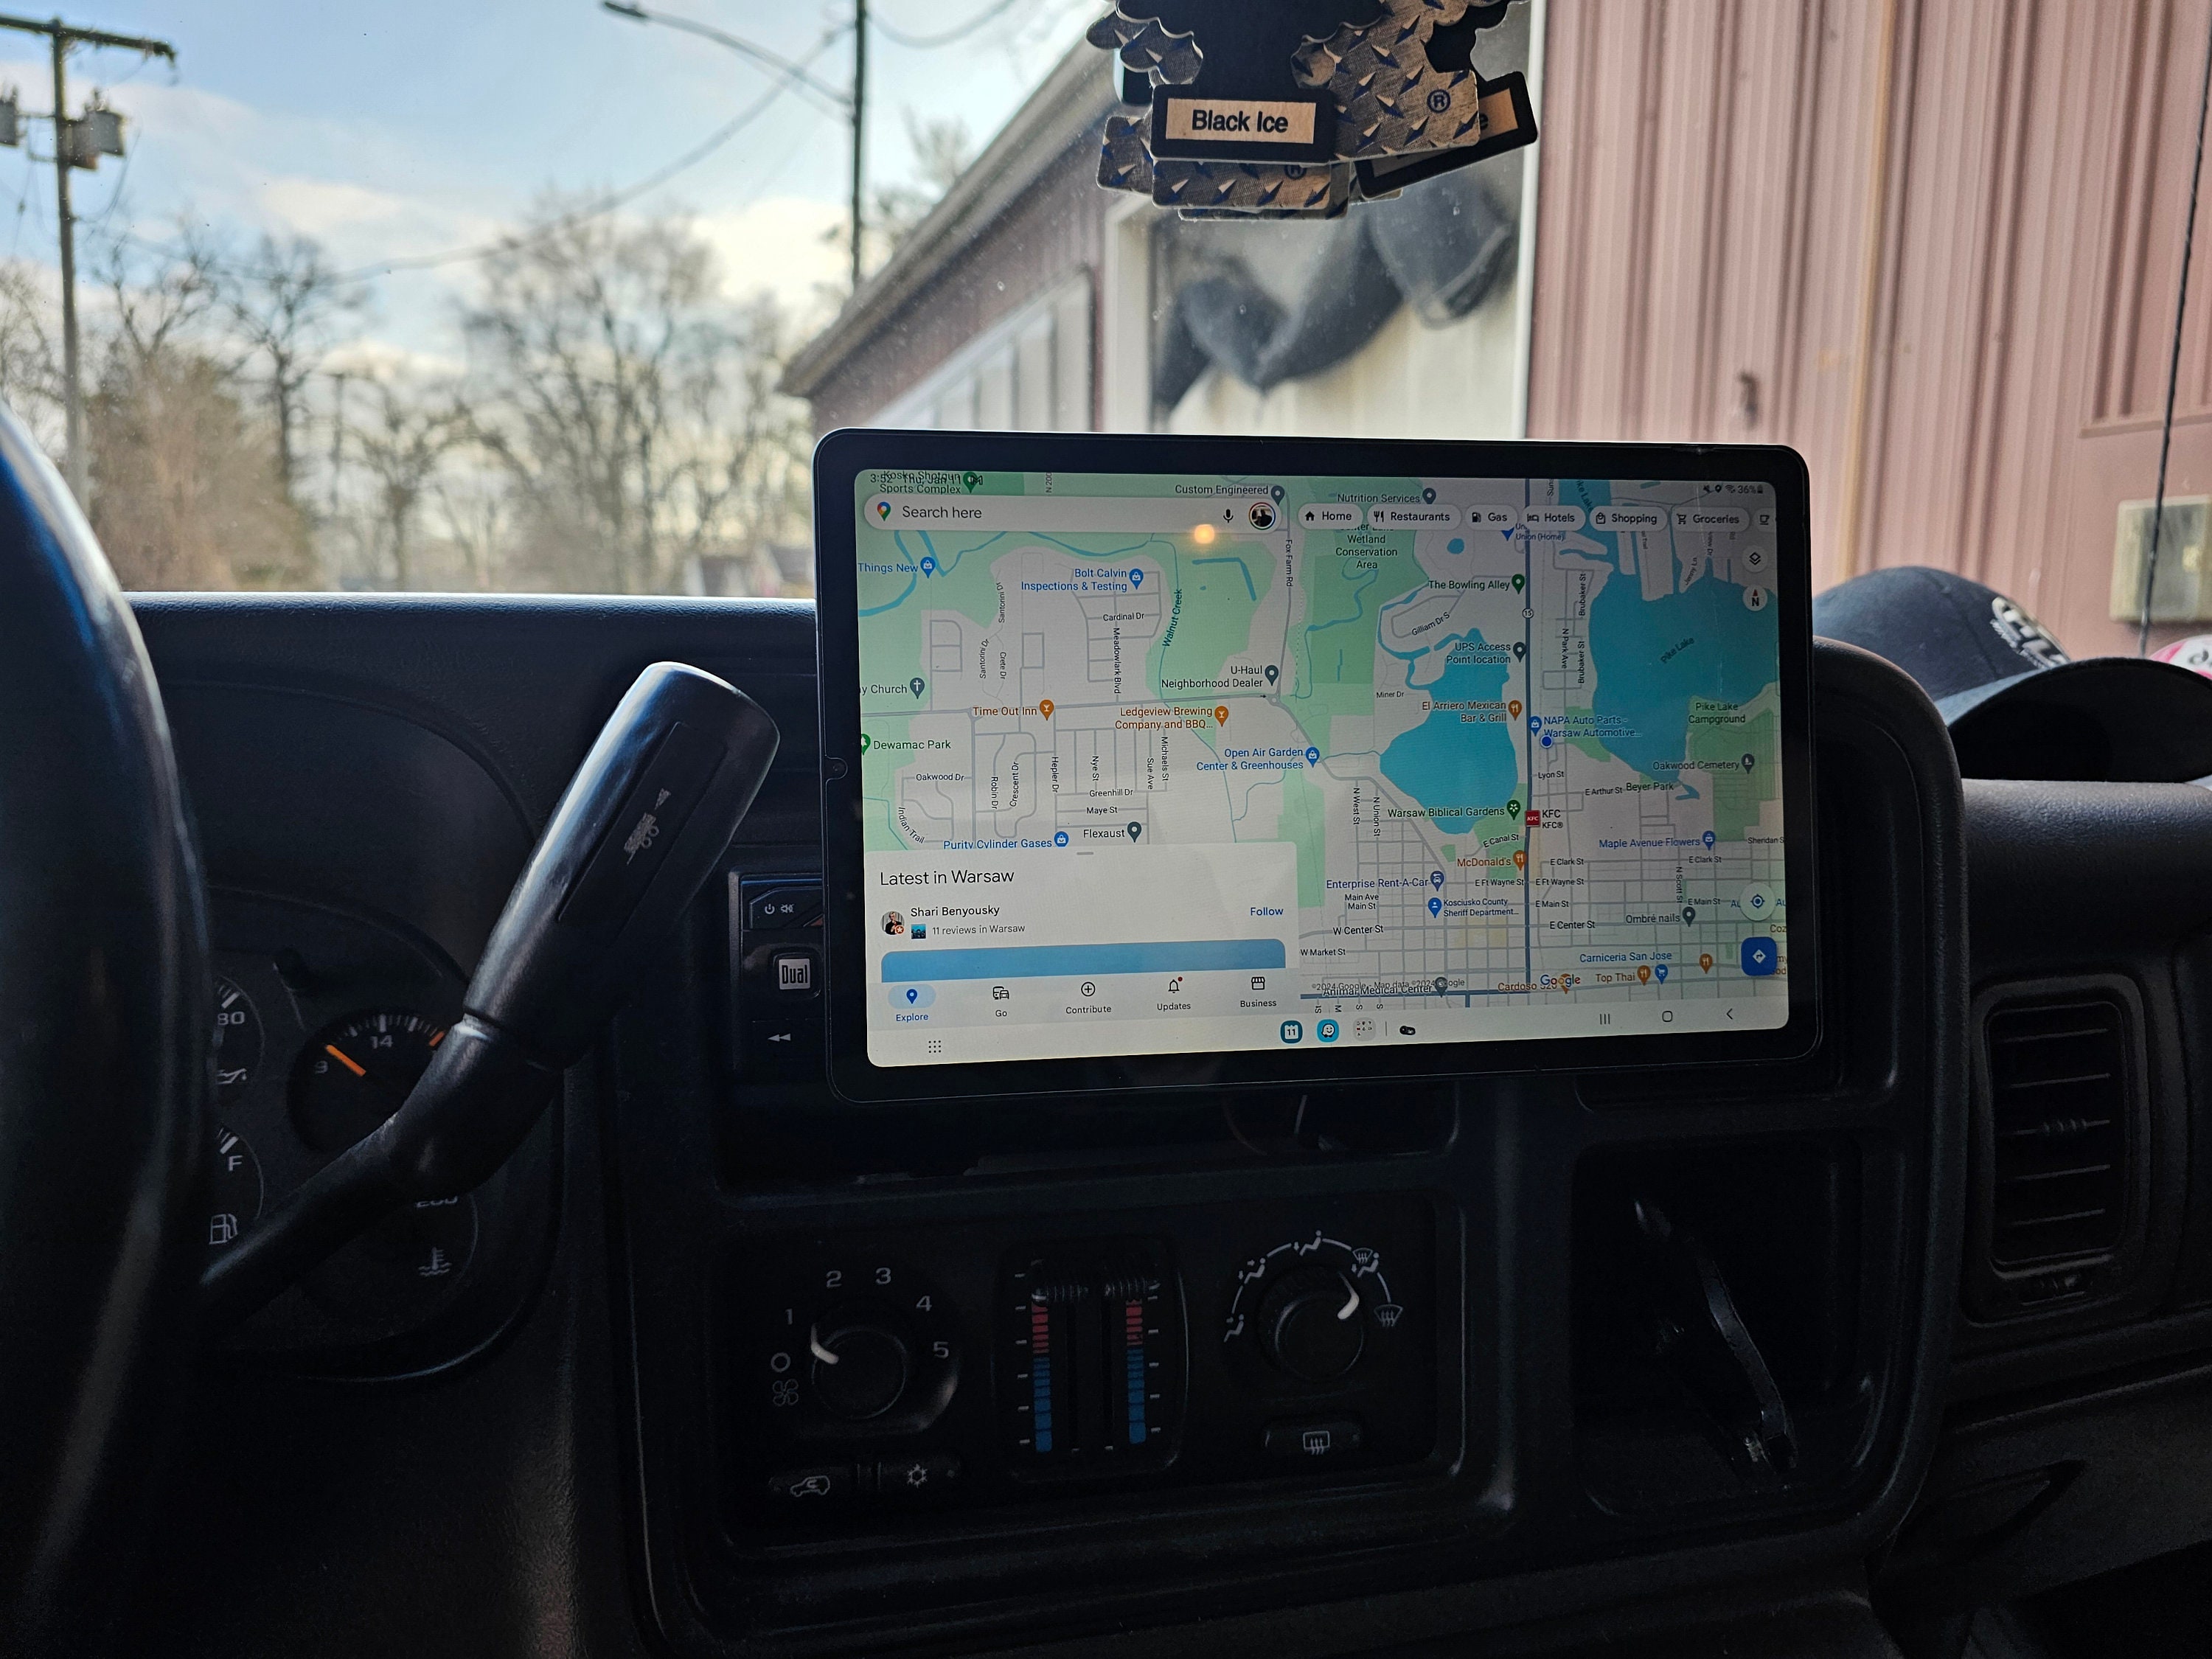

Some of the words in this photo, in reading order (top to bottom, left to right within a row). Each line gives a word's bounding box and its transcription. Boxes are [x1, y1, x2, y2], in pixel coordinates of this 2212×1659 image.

[1192, 110, 1252, 132] Black
[1257, 111, 1289, 133] Ice
[880, 484, 914, 494] Sports
[917, 484, 961, 495] Complex
[1175, 484, 1213, 495] Custom
[1215, 484, 1269, 497] Engineered
[1337, 493, 1378, 503] Nutrition
[1381, 494, 1420, 504] Services
[902, 506, 948, 519] Search
[952, 506, 982, 519] here
[1322, 511, 1352, 521] Home
[1391, 512, 1450, 522] Restaurants
[1487, 512, 1508, 523] Gas
[1544, 512, 1576, 523] Hotels
[1611, 514, 1658, 525] Shopping
[1692, 514, 1740, 525] Groceries
[1347, 535, 1386, 544] Wetland
[1335, 547, 1398, 557] Conservation
[858, 563, 894, 575] Things
[896, 563, 919, 573] New
[1356, 560, 1378, 569] Area
[1074, 568, 1093, 578] Bolt
[1096, 568, 1127, 578] Calvin
[1021, 581, 1079, 593] Inspections
[1081, 582, 1089, 591] &
[1091, 581, 1128, 593] Testing
[1428, 580, 1446, 590] The
[1448, 580, 1486, 591] Bowling
[1487, 580, 1511, 591] Alley
[1751, 597, 1760, 607] N
[1102, 613, 1135, 622] Cardinal
[1136, 612, 1144, 620] Dr
[1162, 615, 1179, 647] Walnut
[1172, 588, 1183, 615] Creek
[1113, 627, 1121, 676] Meadowlark
[1455, 643, 1475, 652] UPS
[1477, 642, 1511, 652] Access
[1447, 655, 1470, 664] Point
[1474, 655, 1511, 664] location
[1230, 665, 1263, 675] U-Haul
[1161, 678, 1230, 691] Neighborhood
[1232, 678, 1263, 689] Dealer
[871, 684, 908, 694] Church
[973, 706, 998, 716] Time
[1001, 706, 1020, 716] Out
[1022, 706, 1037, 716] Inn
[1422, 702, 1430, 711] El
[1433, 702, 1465, 711] Arriero
[1467, 701, 1506, 711] Mexican
[1695, 703, 1714, 712] Pike
[1716, 703, 1739, 712] Lake
[1120, 706, 1172, 719] Ledgeview
[1174, 706, 1212, 719] Brewing
[1461, 714, 1477, 723] Bar
[1479, 714, 1486, 723] &
[1489, 714, 1506, 723] Grill
[1543, 716, 1571, 725] NAPA
[1573, 716, 1594, 725] Auto
[1596, 716, 1622, 725] Parts
[1688, 714, 1746, 725] Campground
[1115, 720, 1161, 732] Company
[1164, 720, 1182, 729] and
[1543, 728, 1581, 737] Warsaw
[873, 741, 925, 751] Dewamac
[928, 740, 951, 750] Park
[1224, 748, 1250, 759] Open
[1251, 748, 1266, 757] Air
[1267, 748, 1303, 757] Garden
[1196, 762, 1229, 771] Center
[1231, 762, 1238, 771] &
[1240, 761, 1304, 771] Greenhouses
[1652, 762, 1694, 771] Oakwood
[1697, 761, 1739, 771] Cemetery
[916, 773, 953, 782] Oakwood
[955, 773, 964, 781] Dr
[1626, 783, 1651, 793] Beyer
[1653, 782, 1674, 791] Park
[1087, 807, 1107, 815] Maye
[1110, 806, 1118, 814] St
[1388, 809, 1426, 818] Warsaw
[1428, 808, 1463, 818] Biblical
[1466, 807, 1505, 816] Gardens
[1542, 810, 1561, 818] KFC
[1083, 829, 1125, 838] Flexaust
[1020, 839, 1052, 848] Gases
[1599, 839, 1627, 849] Maple
[1630, 838, 1663, 847] Avenue
[1665, 838, 1700, 846] Flowers
[1457, 858, 1512, 868] McDonald's
[880, 871, 930, 886] Latest
[933, 870, 947, 884] in
[951, 869, 1015, 883] Warsaw
[1326, 880, 1374, 890] Enterprise
[1377, 878, 1429, 887] Rent-A-Car
[1344, 893, 1362, 901] Main
[1365, 893, 1380, 901] Ave
[1443, 898, 1481, 907] Kosciusko
[1482, 898, 1508, 907] County
[911, 906, 939, 917] Shari
[942, 905, 1000, 919] Benyousky
[1250, 907, 1284, 916] Follow
[1444, 908, 1468, 917] Sheriff
[1658, 914, 1680, 922] nails
[932, 927, 940, 935] 11
[942, 926, 976, 934] reviews
[979, 925, 987, 933] in
[990, 924, 1026, 933] Warsaw
[1332, 927, 1342, 935] W
[1343, 926, 1373, 934] Center
[1374, 925, 1384, 933] St
[1557, 921, 1585, 930] Center
[1586, 920, 1596, 929] St
[1579, 953, 1627, 962] Carniceria
[1629, 953, 1647, 961] San
[1649, 951, 1672, 961] Jose
[782, 964, 808, 984] Dual
[1596, 974, 1613, 983] Top
[1615, 973, 1635, 982] Thai
[1540, 974, 1581, 987] Google
[1498, 982, 1537, 992] Cardoso
[1157, 1002, 1192, 1012] Updates
[1239, 999, 1277, 1008] Business
[995, 1009, 1007, 1018] Go
[1065, 1005, 1112, 1015] Contribute
[896, 1013, 929, 1023] Explore
[1286, 1028, 1296, 1037] 11
[370, 1034, 393, 1048] 14
[229, 1155, 243, 1171] F
[826, 1270, 842, 1289] 2
[875, 1267, 892, 1285] 3
[916, 1295, 933, 1312] 4
[933, 1341, 950, 1359] 5
